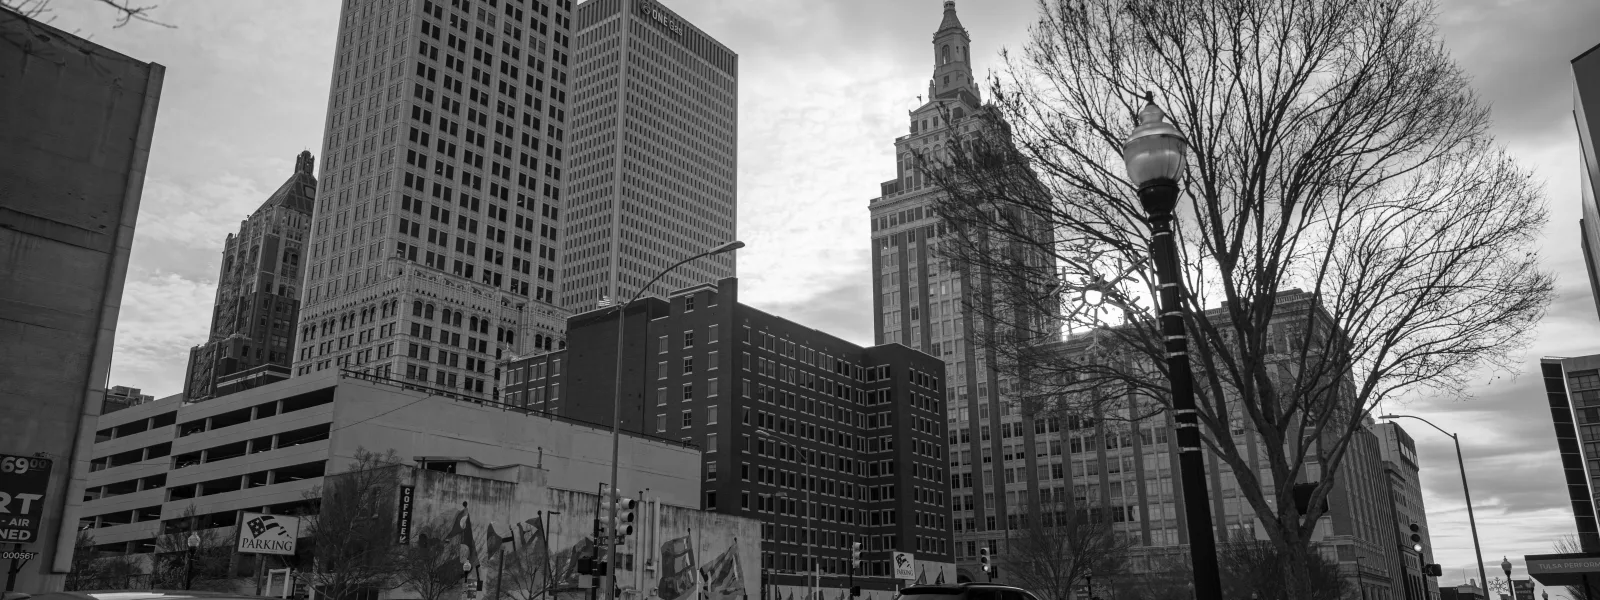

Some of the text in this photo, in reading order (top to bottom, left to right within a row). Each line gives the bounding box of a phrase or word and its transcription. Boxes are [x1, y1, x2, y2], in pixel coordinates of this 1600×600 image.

[652, 9, 668, 27] ONE
[0, 491, 44, 515] RT
[400, 487, 411, 535] COFFEE
[8, 517, 30, 527] AIR
[0, 528, 31, 541] NED
[241, 537, 293, 551] PARKING
[2, 551, 35, 560] 000561
[1537, 562, 1563, 570] TULSA
